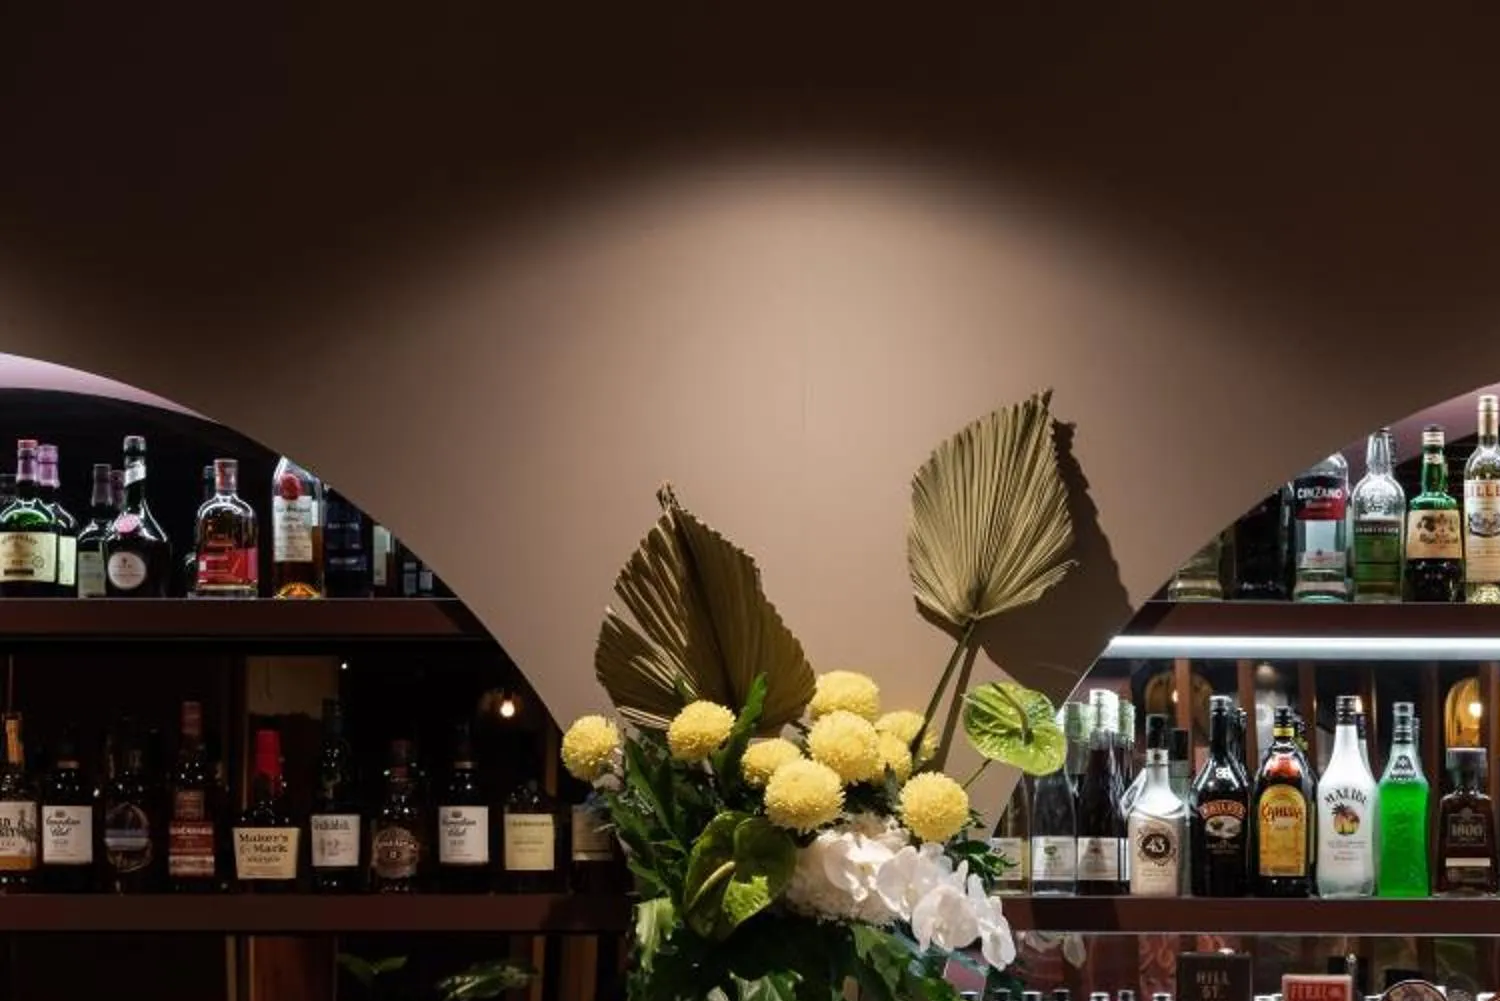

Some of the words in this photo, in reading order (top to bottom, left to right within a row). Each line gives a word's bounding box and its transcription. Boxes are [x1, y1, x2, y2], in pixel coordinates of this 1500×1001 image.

[1297, 487, 1343, 499] CINZANO
[1324, 786, 1368, 804] MALIBU
[240, 834, 289, 843] Maker's
[254, 844, 288, 854] Mark
[1145, 839, 1166, 853] 43
